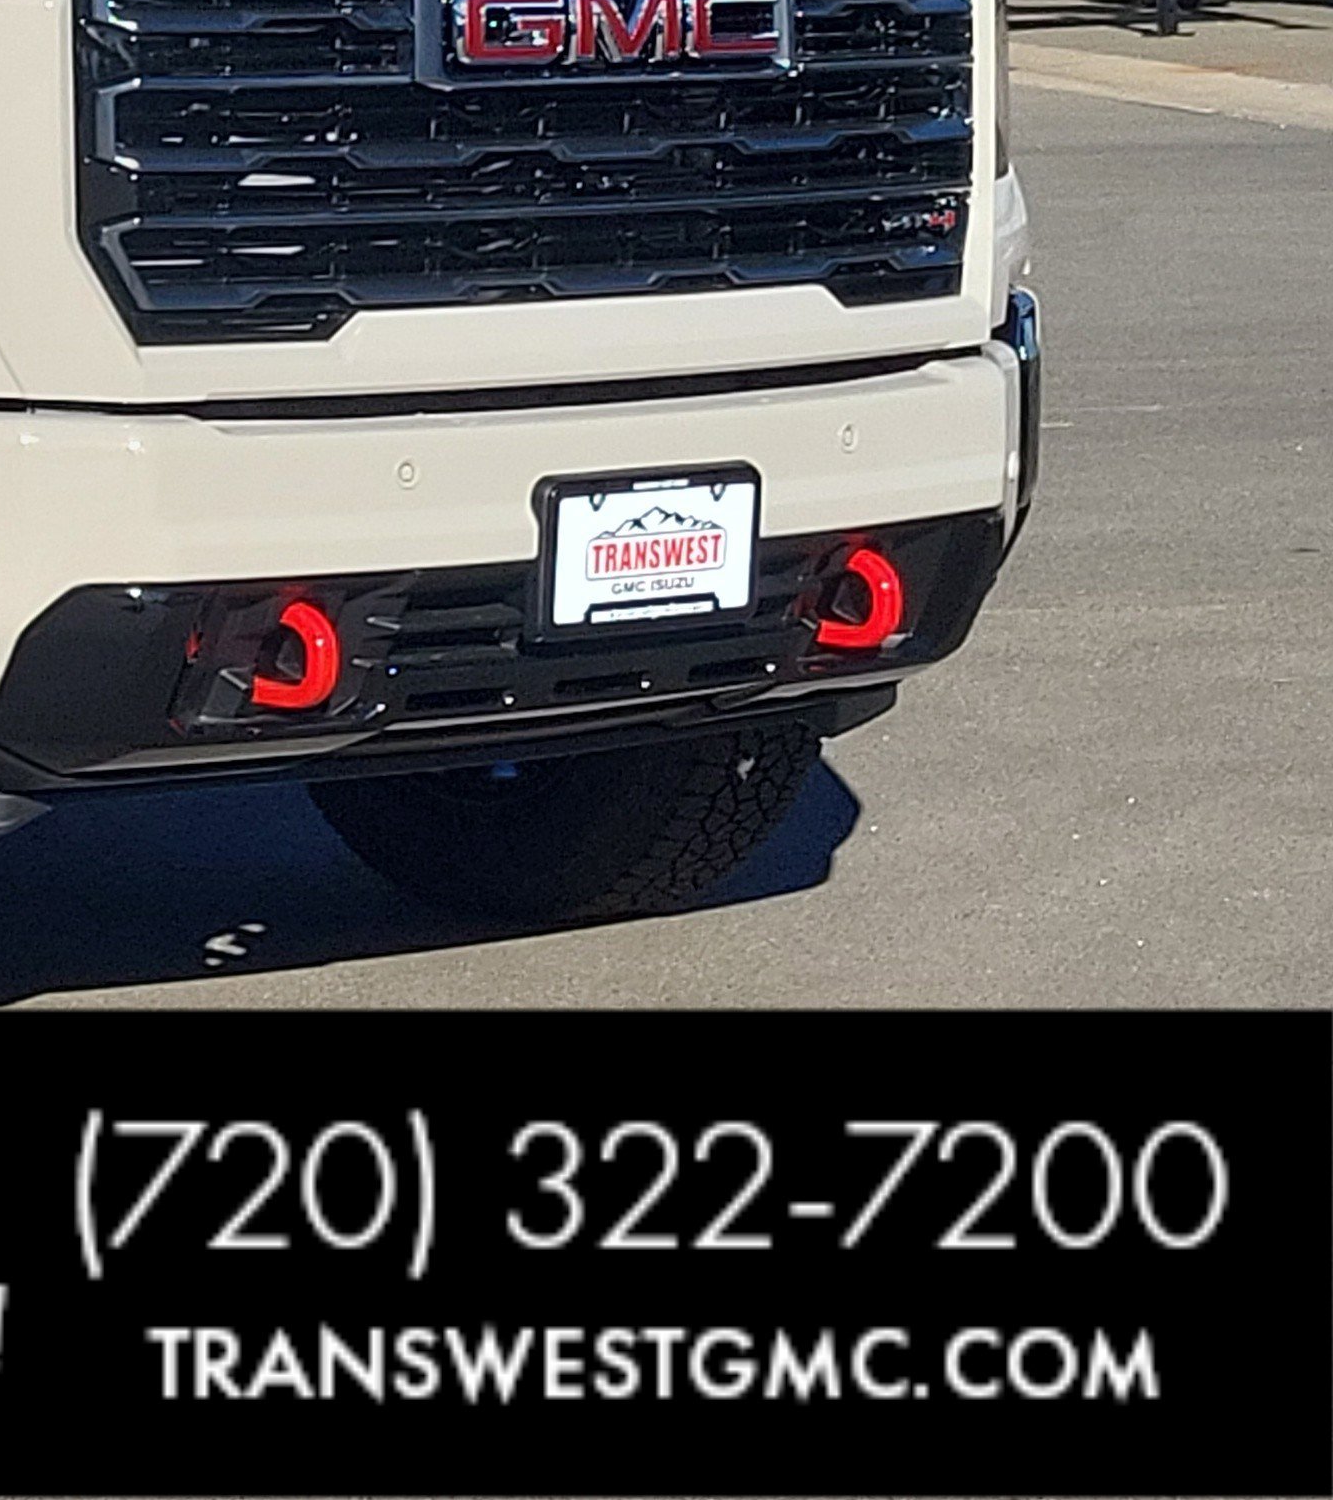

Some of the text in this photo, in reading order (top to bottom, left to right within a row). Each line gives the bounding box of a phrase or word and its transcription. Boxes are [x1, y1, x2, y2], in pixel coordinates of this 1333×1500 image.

[592, 534, 722, 574] TRANSWEST
[611, 577, 695, 594] GMC ISUZU
